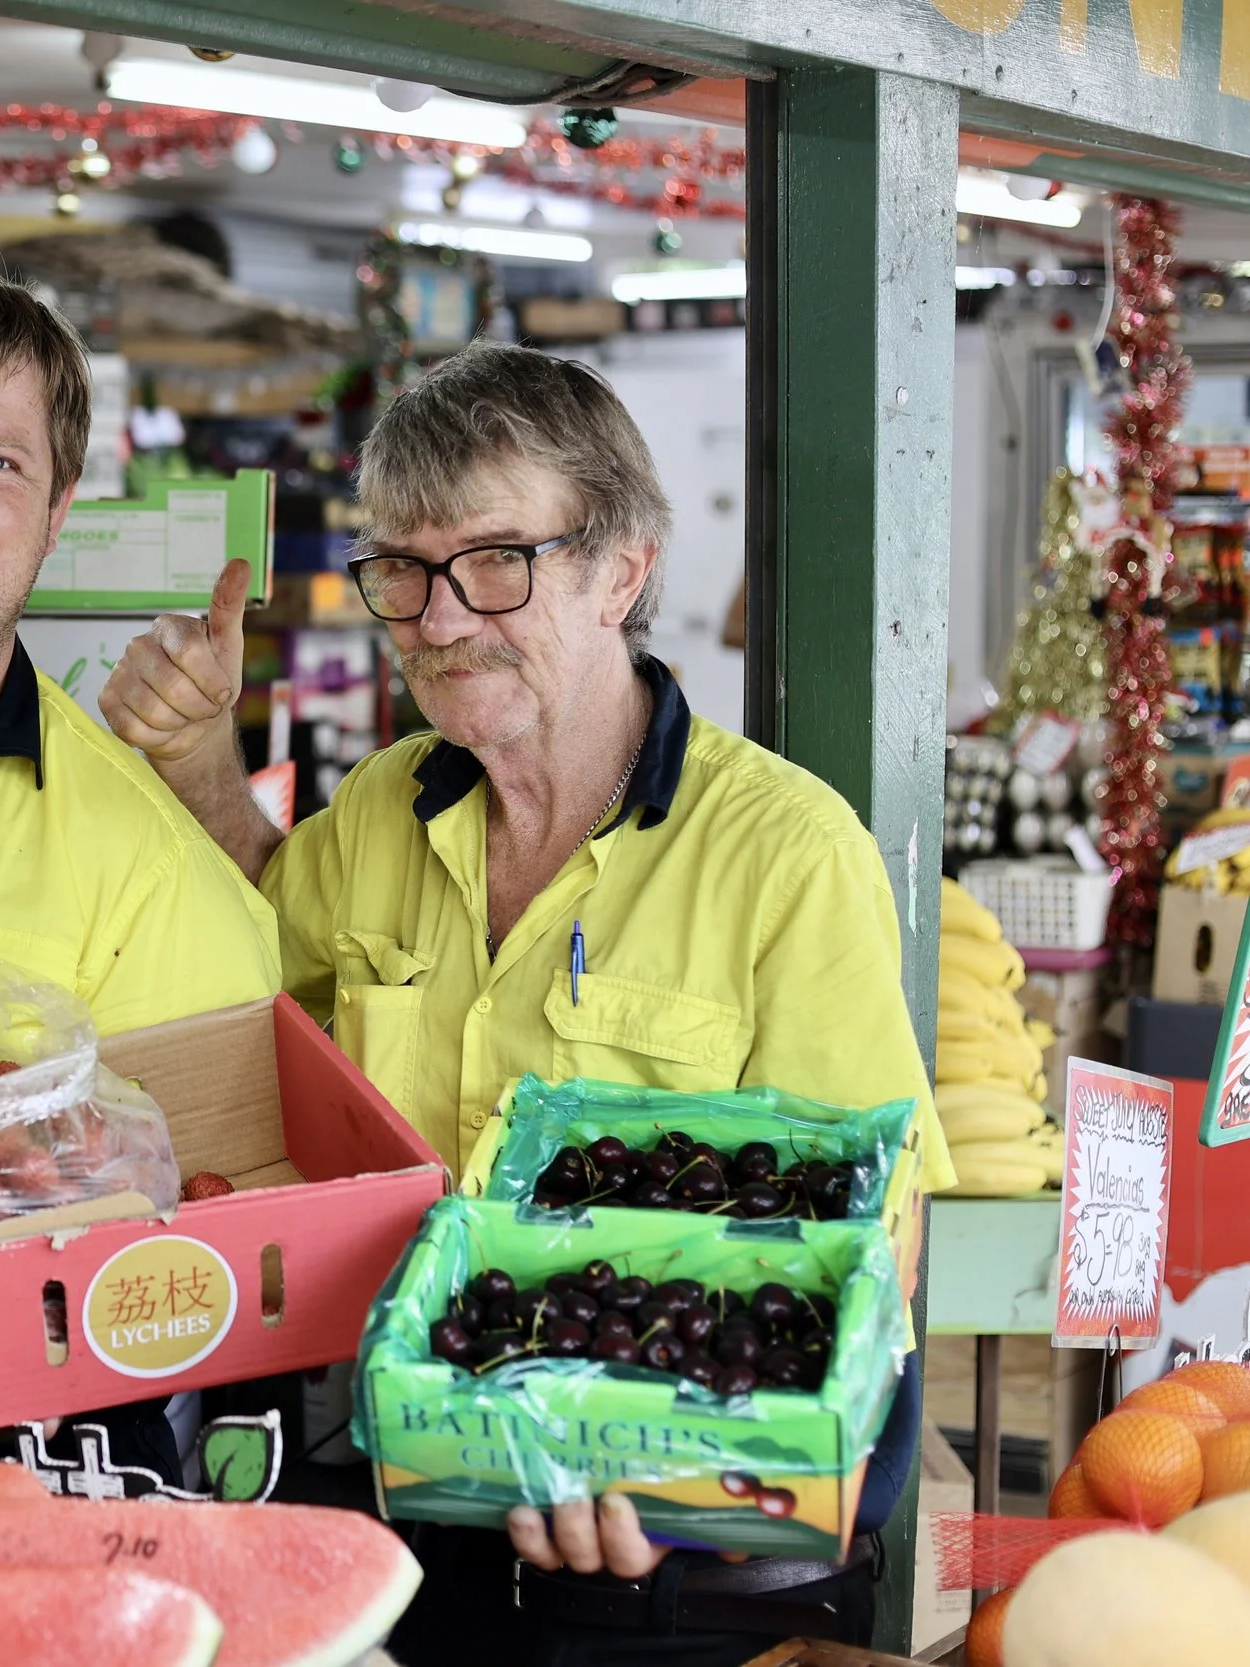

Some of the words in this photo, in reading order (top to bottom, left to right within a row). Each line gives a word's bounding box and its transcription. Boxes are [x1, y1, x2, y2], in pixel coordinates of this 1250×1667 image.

[58, 530, 120, 541] NGOES
[1087, 1142, 1144, 1204] Valencias
[105, 1265, 214, 1327] 荔枝
[111, 1313, 211, 1349] LYCHEES
[461, 1446, 662, 1480] CHRRIS
